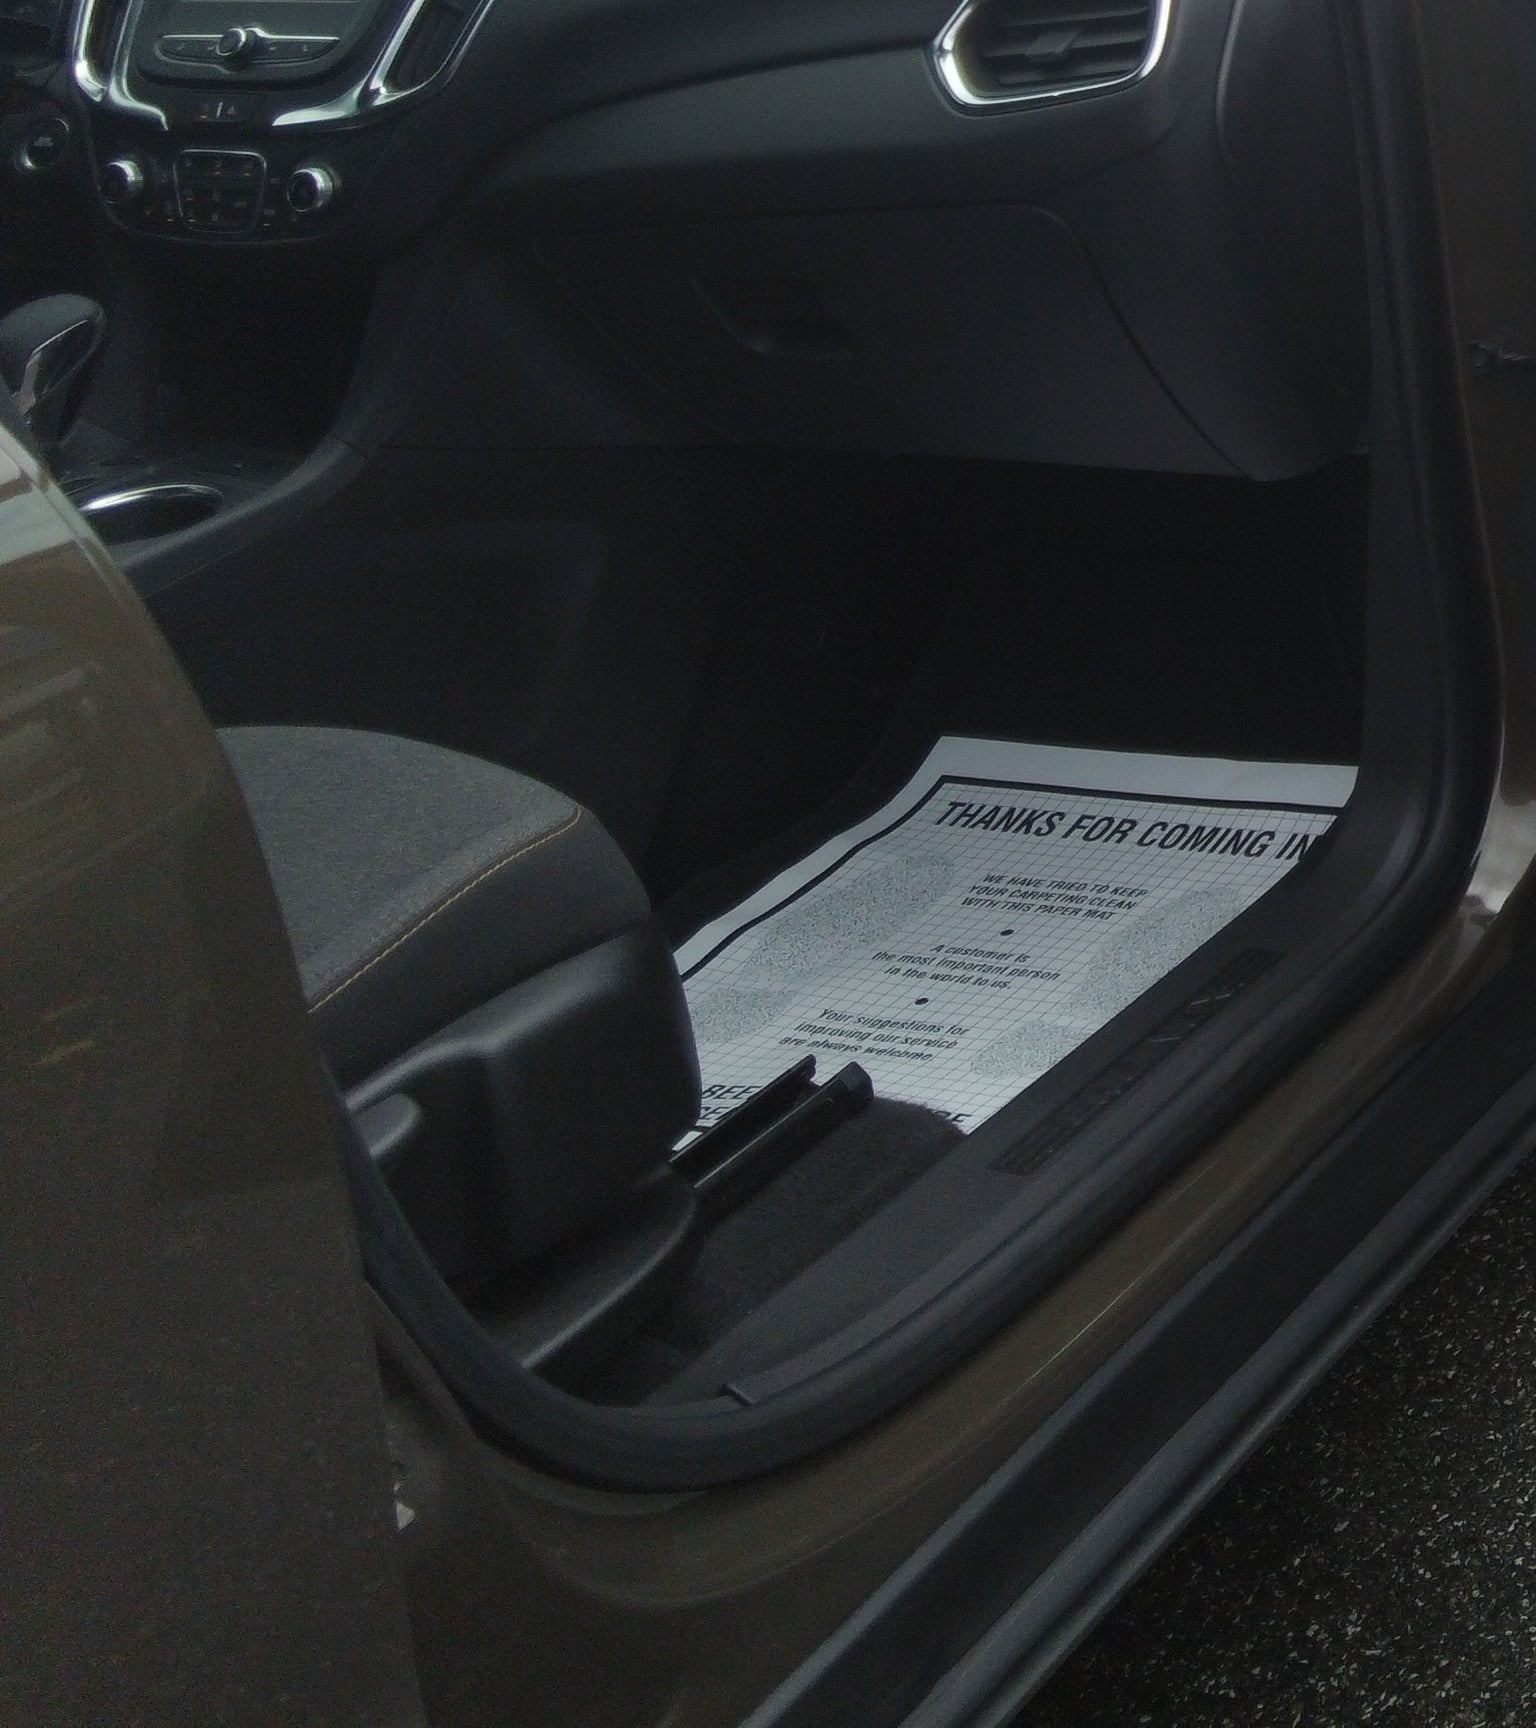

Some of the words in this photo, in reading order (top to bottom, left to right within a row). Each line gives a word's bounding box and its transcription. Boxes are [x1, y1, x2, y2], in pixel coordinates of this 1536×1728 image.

[934, 801, 1066, 838] THANKS
[1062, 814, 1139, 844] FOR
[1137, 821, 1279, 859] COMING
[1275, 832, 1318, 860] IN
[969, 884, 1009, 897] YOUR
[1009, 889, 1089, 905] CARPETING
[1088, 895, 1138, 911] CLEAN
[982, 874, 1007, 884] WE
[1007, 875, 1046, 888] HAVE
[1047, 879, 1089, 892] TRIED
[1089, 883, 1111, 894] TO
[1109, 885, 1150, 898] KEEP
[961, 897, 1001, 909] WITH
[1000, 901, 1033, 913] THIS
[1033, 904, 1082, 917] PAPER
[1082, 908, 1117, 920] MAT
[930, 943, 945, 953] A
[944, 946, 1014, 962] customer
[1013, 953, 1031, 963] is
[872, 950, 898, 961] the
[897, 953, 935, 966] most
[935, 957, 1009, 977] important
[1005, 967, 1061, 982] person
[884, 966, 902, 975] in
[901, 967, 927, 979] the
[928, 973, 972, 985] world
[972, 977, 990, 987] to
[818, 1008, 855, 1023] Your
[854, 1015, 944, 1034] suggestions
[945, 1024, 971, 1036] for
[778, 1037, 807, 1048] are
[806, 1039, 863, 1054] always
[794, 1021, 872, 1042] improving
[872, 1033, 904, 1044] our
[903, 1035, 959, 1050] service
